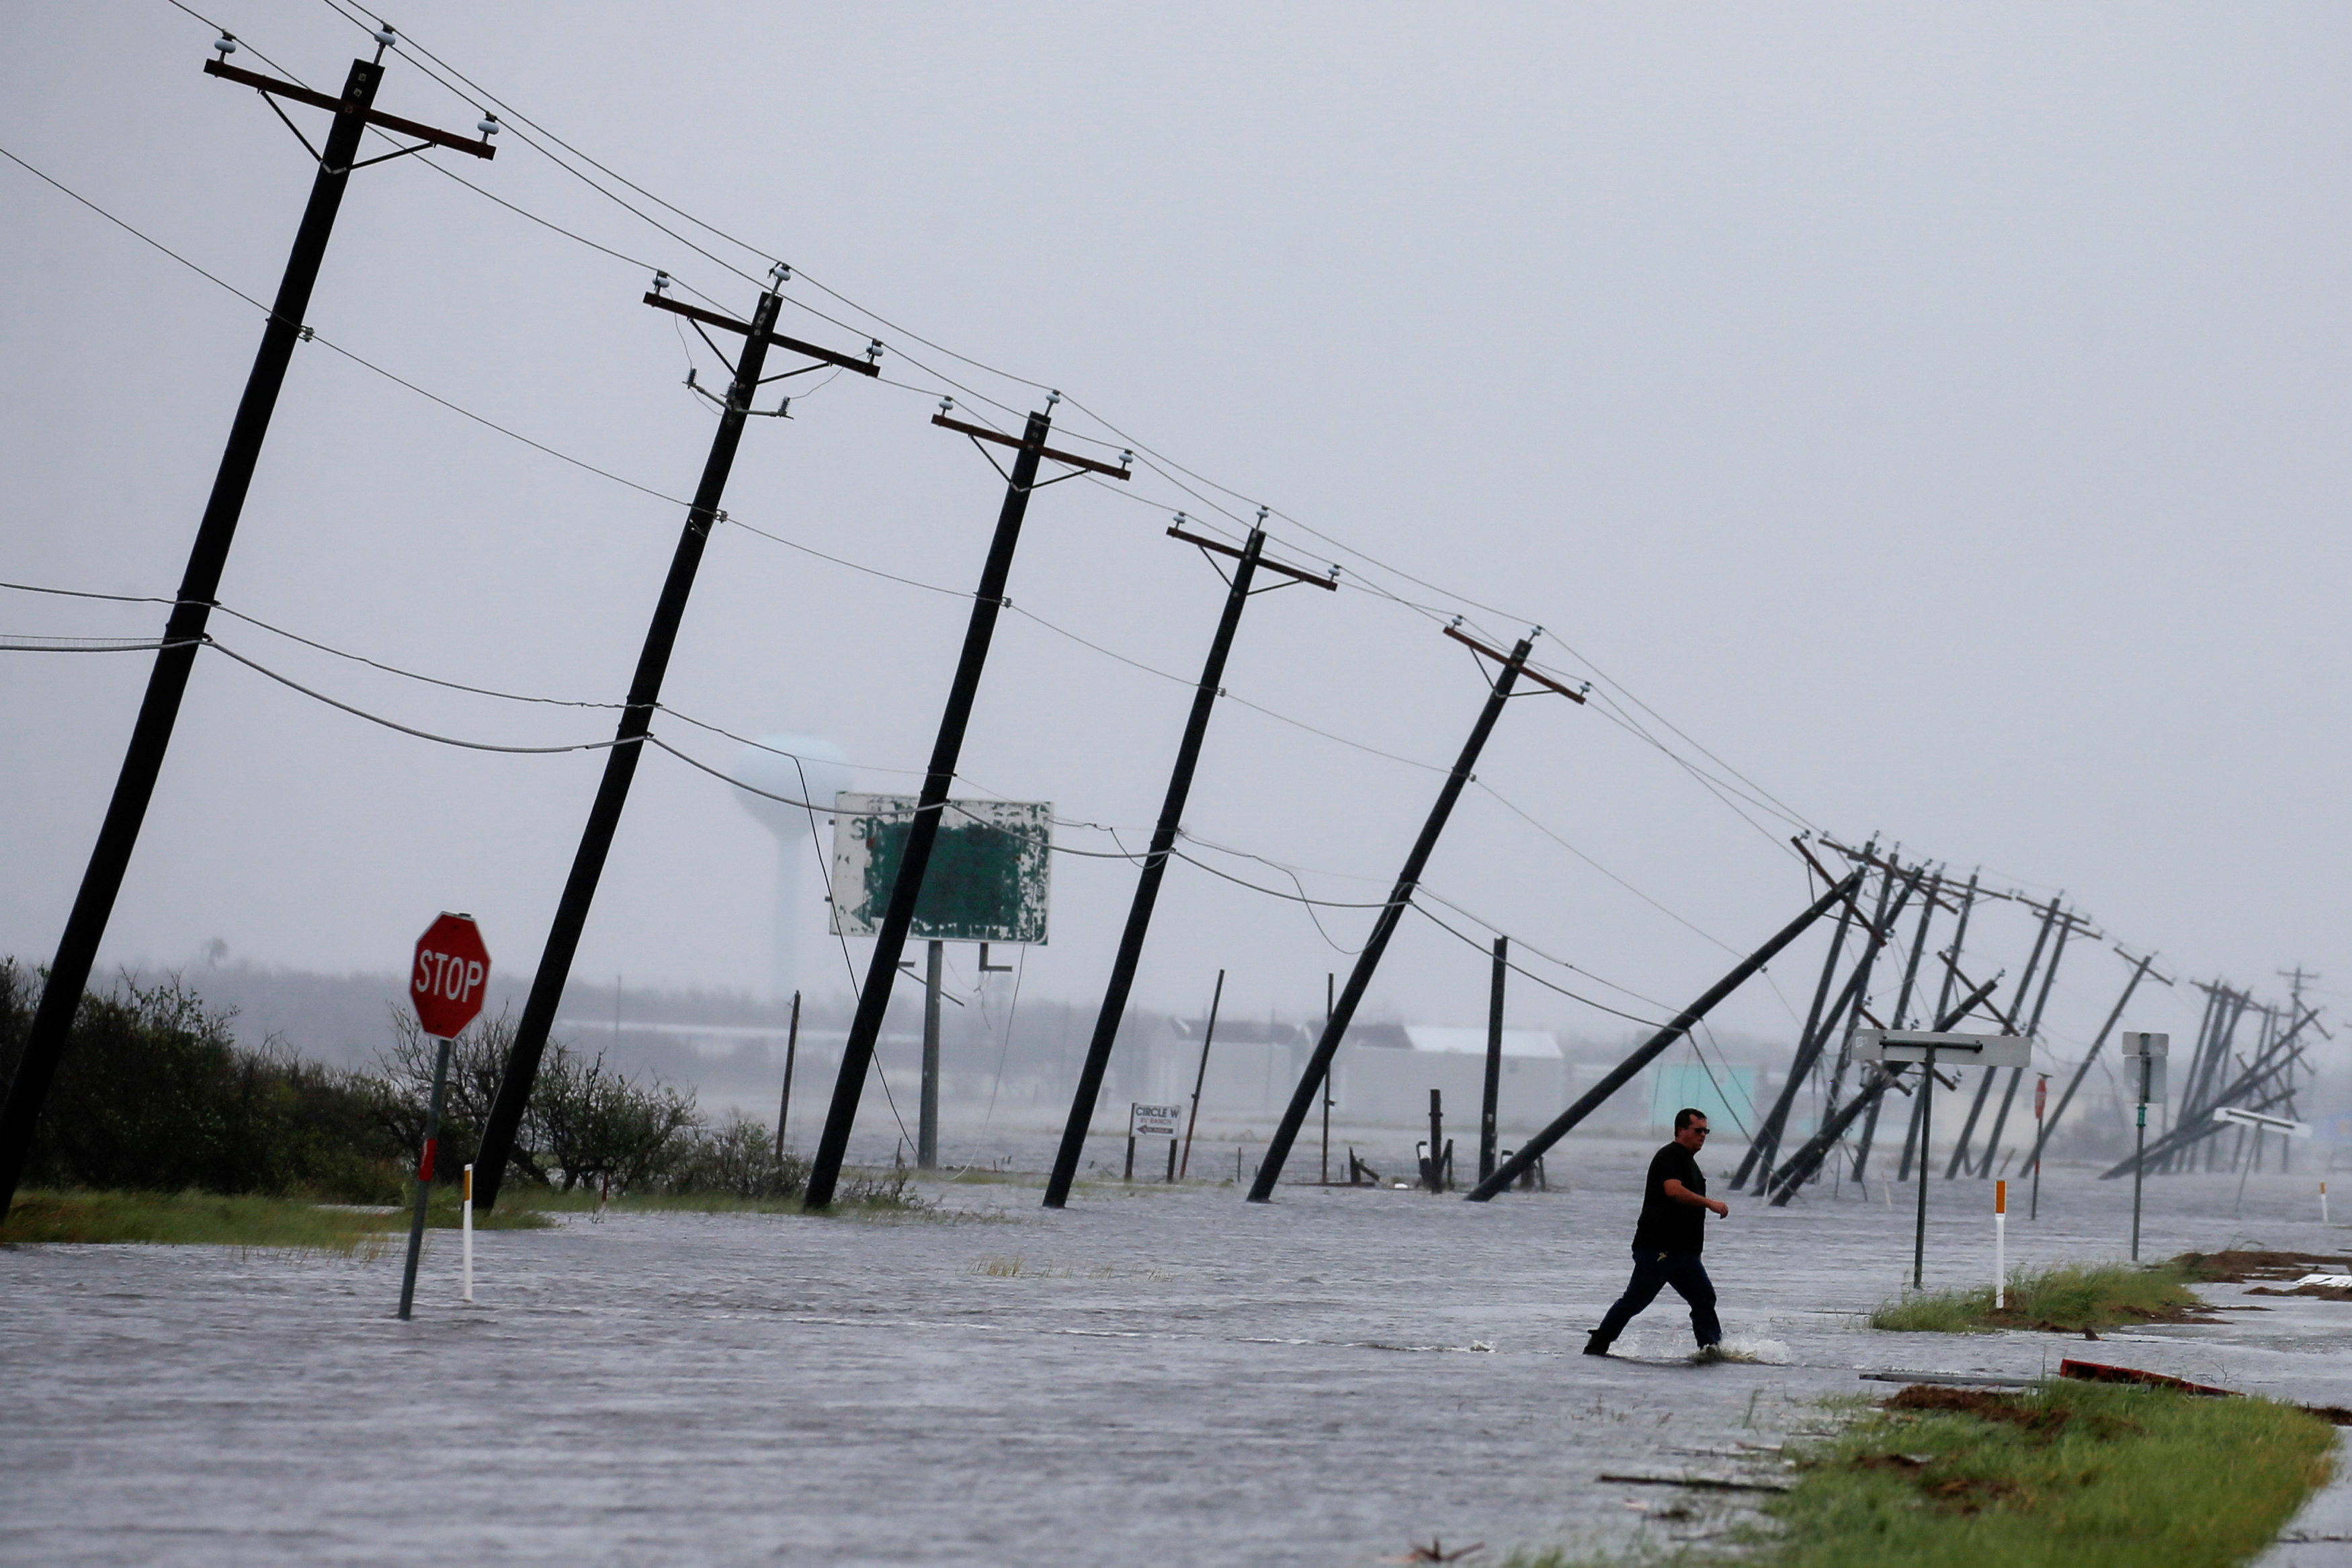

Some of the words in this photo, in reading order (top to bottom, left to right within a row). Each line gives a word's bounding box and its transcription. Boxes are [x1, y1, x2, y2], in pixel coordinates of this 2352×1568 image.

[416, 950, 482, 1002] STOP
[1136, 1107, 1167, 1117] CIRCLE
[1171, 1108, 1179, 1119] W
